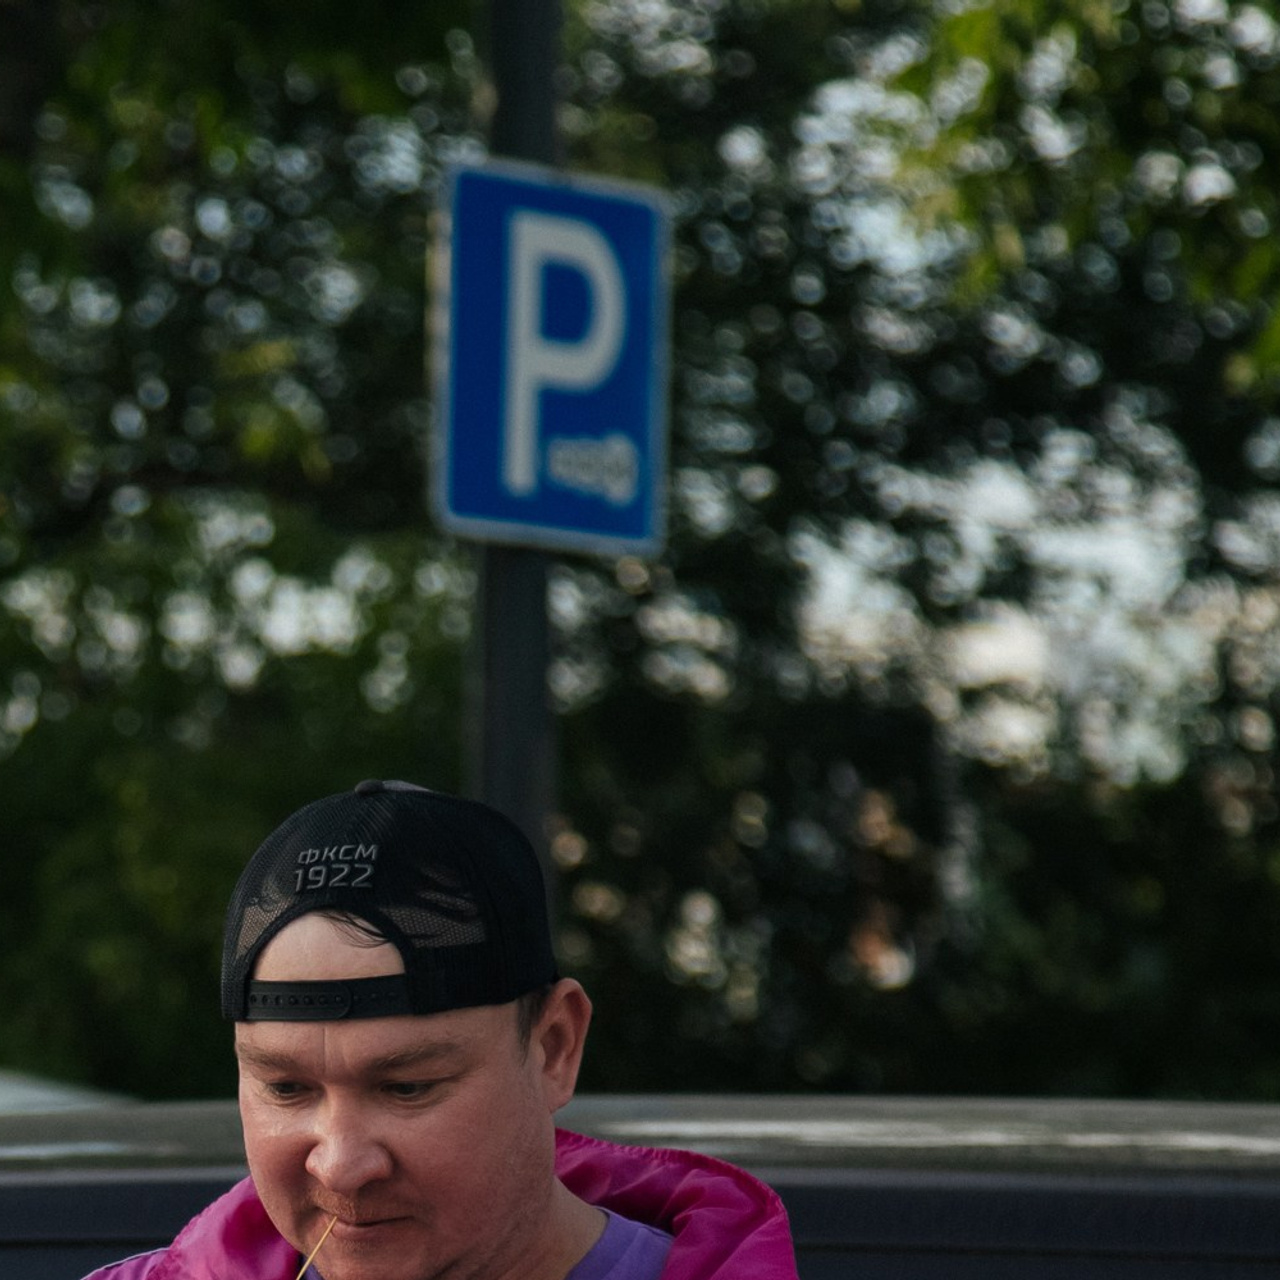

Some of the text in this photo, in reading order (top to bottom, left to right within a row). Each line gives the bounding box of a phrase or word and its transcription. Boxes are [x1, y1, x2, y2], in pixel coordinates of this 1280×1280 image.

[503, 208, 628, 496] P
[298, 843, 377, 864] ФКСМ
[294, 864, 374, 892] 1922
